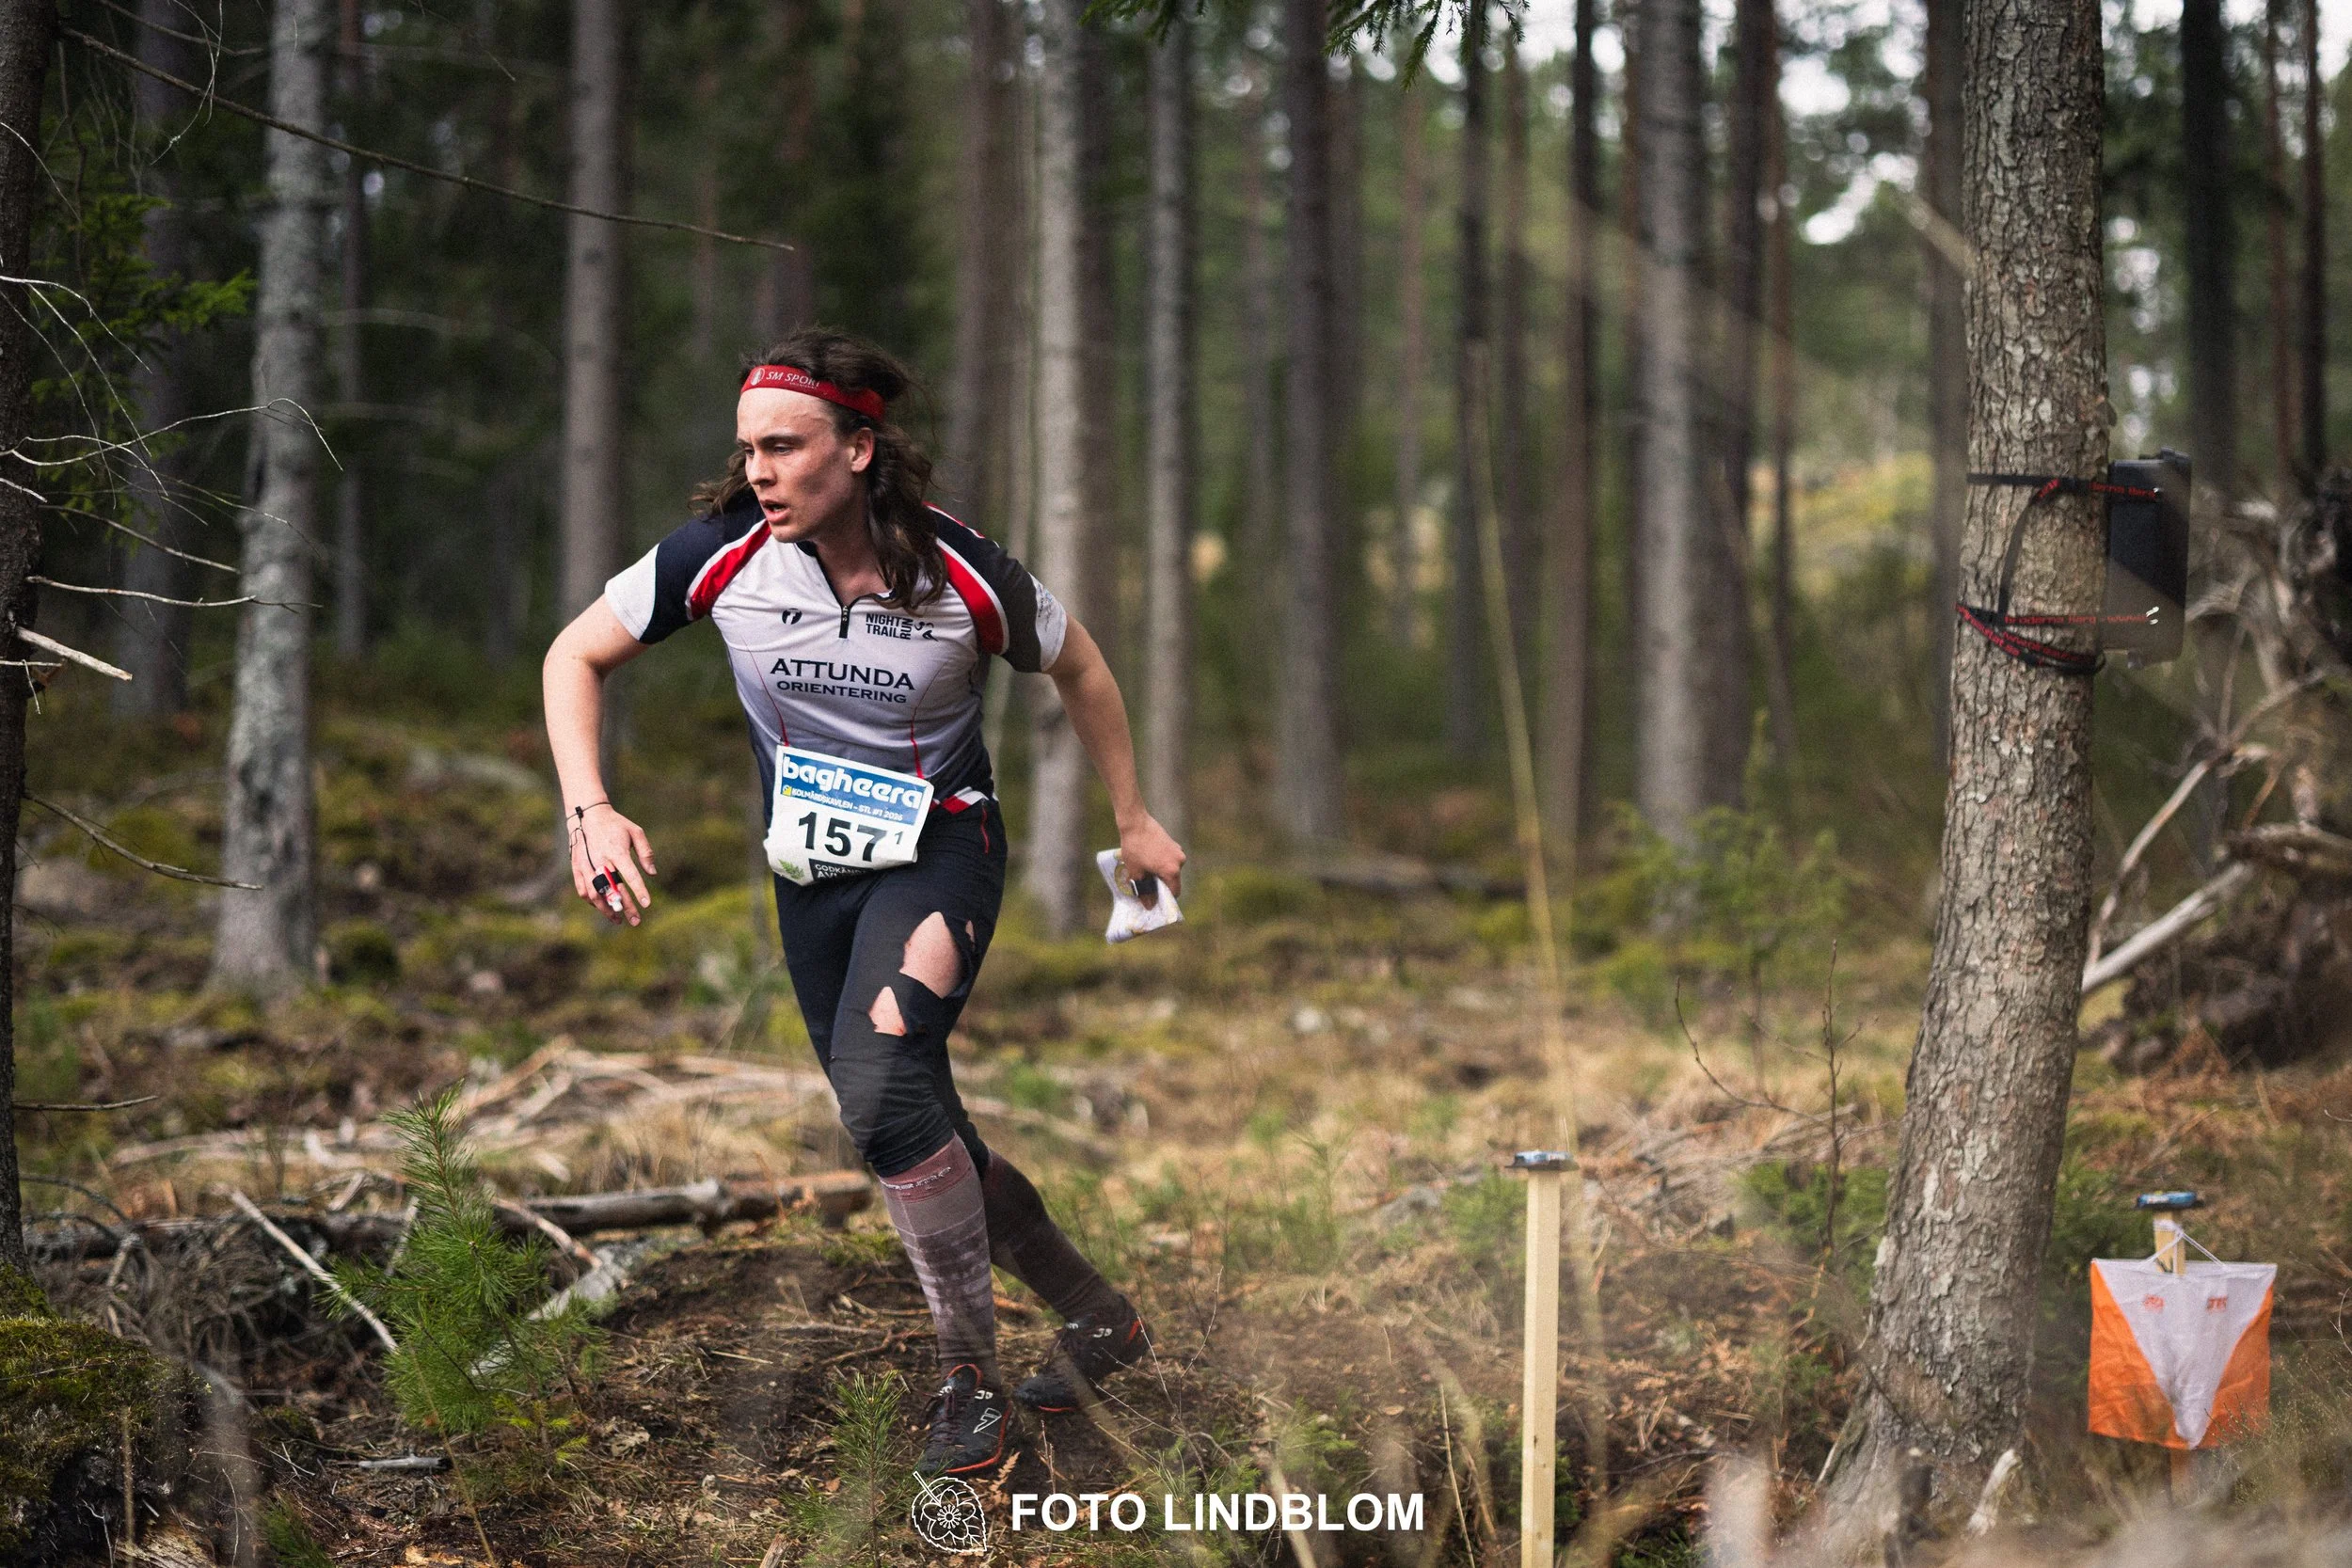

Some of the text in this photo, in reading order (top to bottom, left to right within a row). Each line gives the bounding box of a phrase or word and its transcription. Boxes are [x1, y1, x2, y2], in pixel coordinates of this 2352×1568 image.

[766, 371, 784, 381] SM
[866, 613, 901, 627] NIGHT
[866, 623, 900, 639] TRAIL
[899, 618, 914, 640] RUN
[770, 658, 915, 690] ATTUNDA
[776, 680, 907, 704] ORIENTERING
[782, 754, 924, 810] bagheera
[798, 811, 904, 863] 157 1
